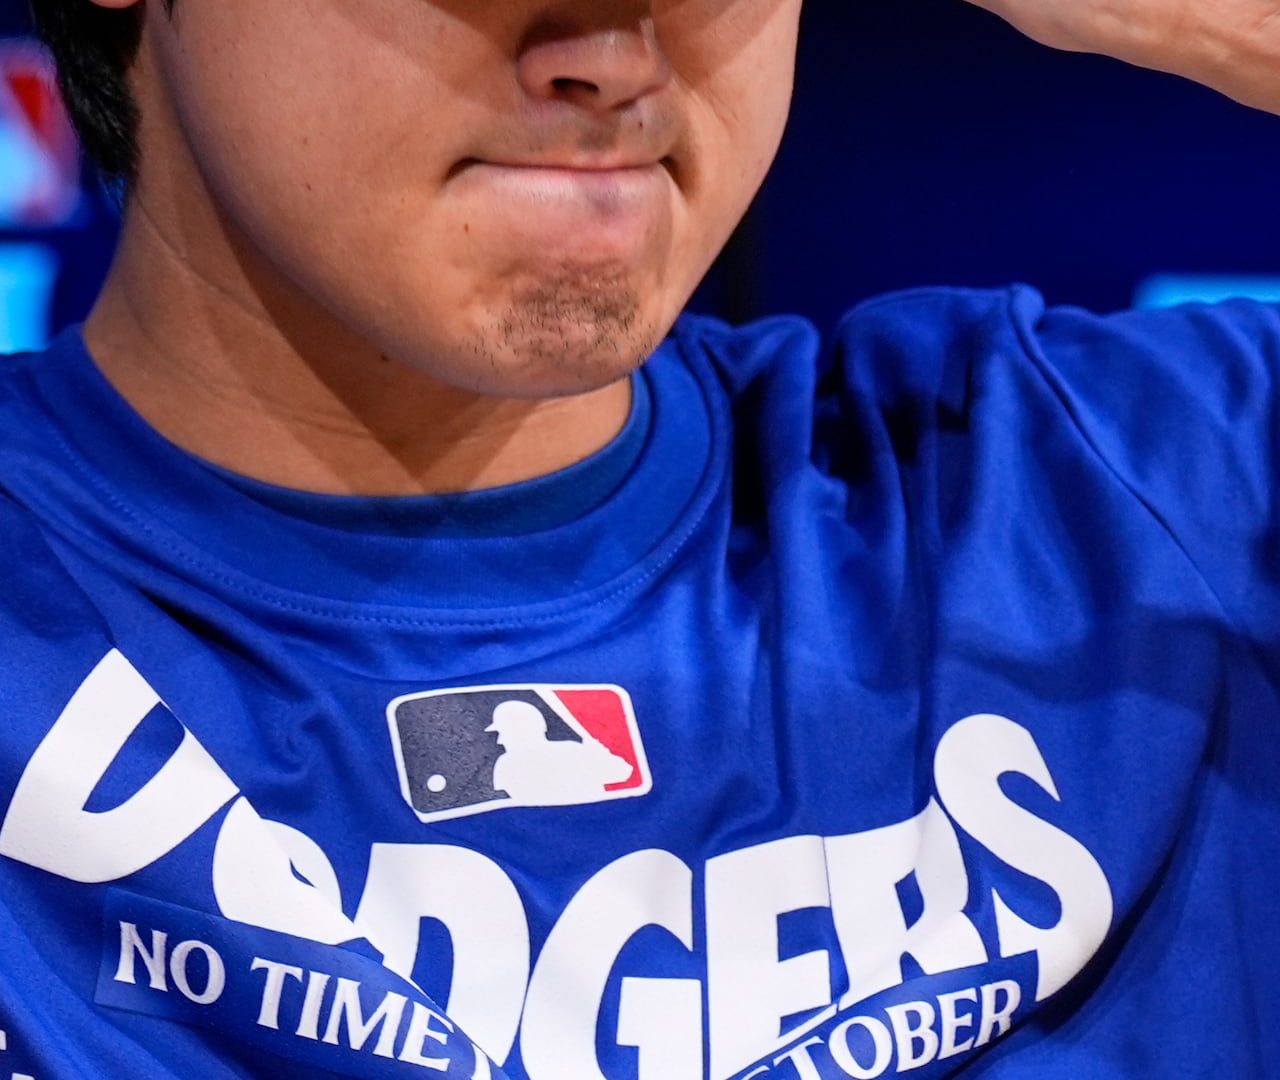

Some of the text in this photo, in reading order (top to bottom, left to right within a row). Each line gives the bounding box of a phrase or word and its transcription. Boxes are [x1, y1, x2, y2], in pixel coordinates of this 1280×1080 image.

[114, 920, 455, 1072] NO TIME
[736, 978, 1021, 1080] TOBER
